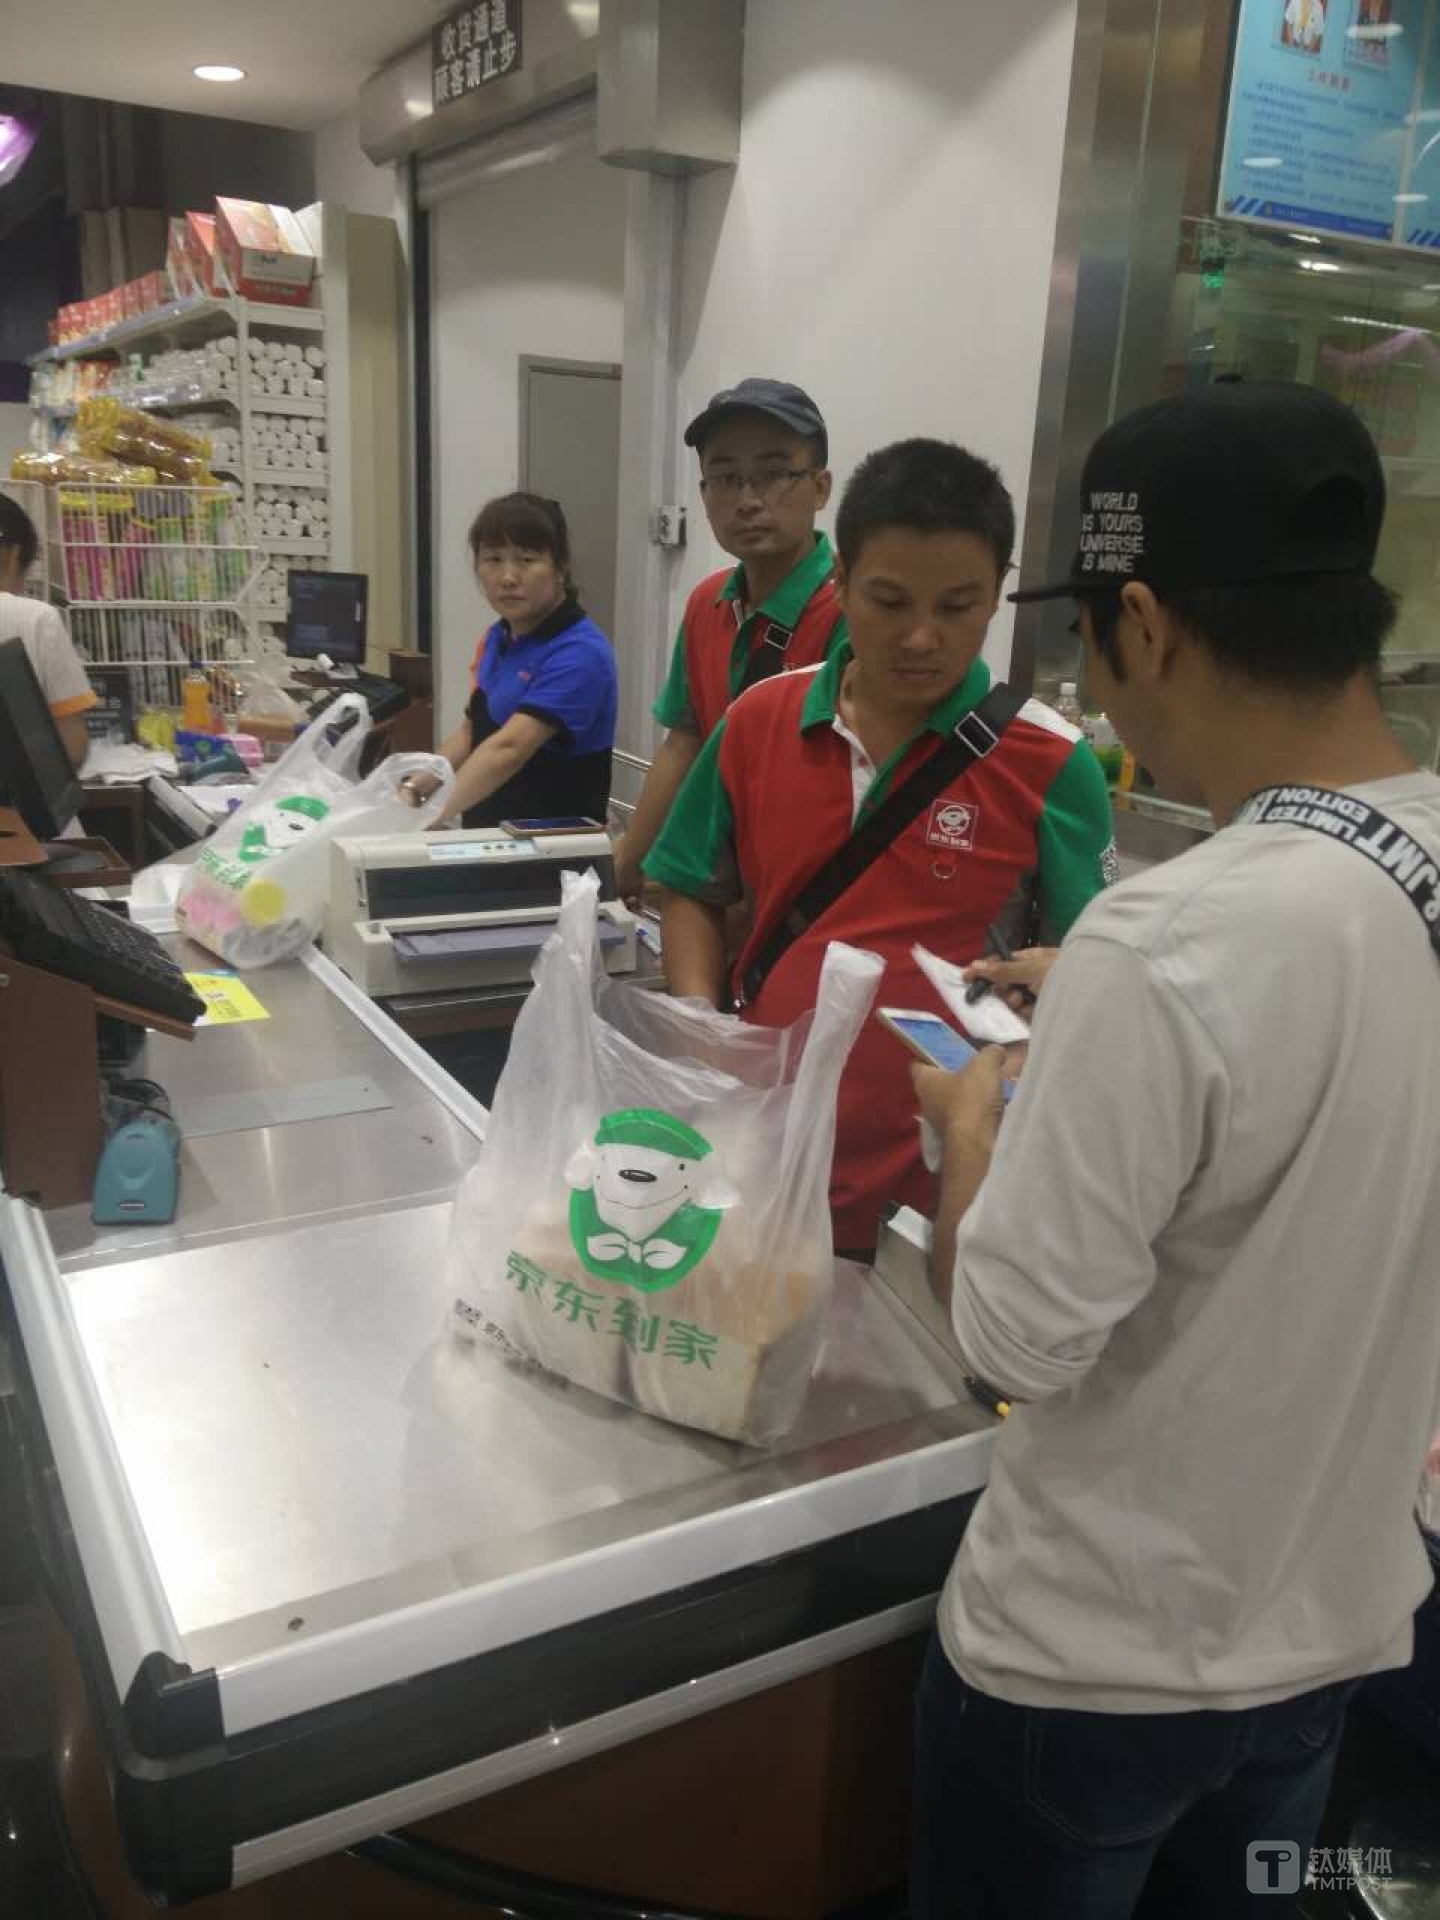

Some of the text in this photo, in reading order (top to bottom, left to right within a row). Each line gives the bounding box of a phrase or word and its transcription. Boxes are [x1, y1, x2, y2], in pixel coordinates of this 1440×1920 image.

[434, 29, 516, 102] 顾客请止步
[1090, 491, 1139, 511] WORLD
[1082, 513, 1144, 533] IS YOURS
[1080, 533, 1145, 554] UNIVERSE
[1082, 552, 1135, 574] IS MINE
[1265, 805, 1360, 841] LIMITED
[1275, 787, 1372, 823] EDITION
[1355, 821, 1439, 892] JMT
[505, 1249, 720, 1370] 京东到家
